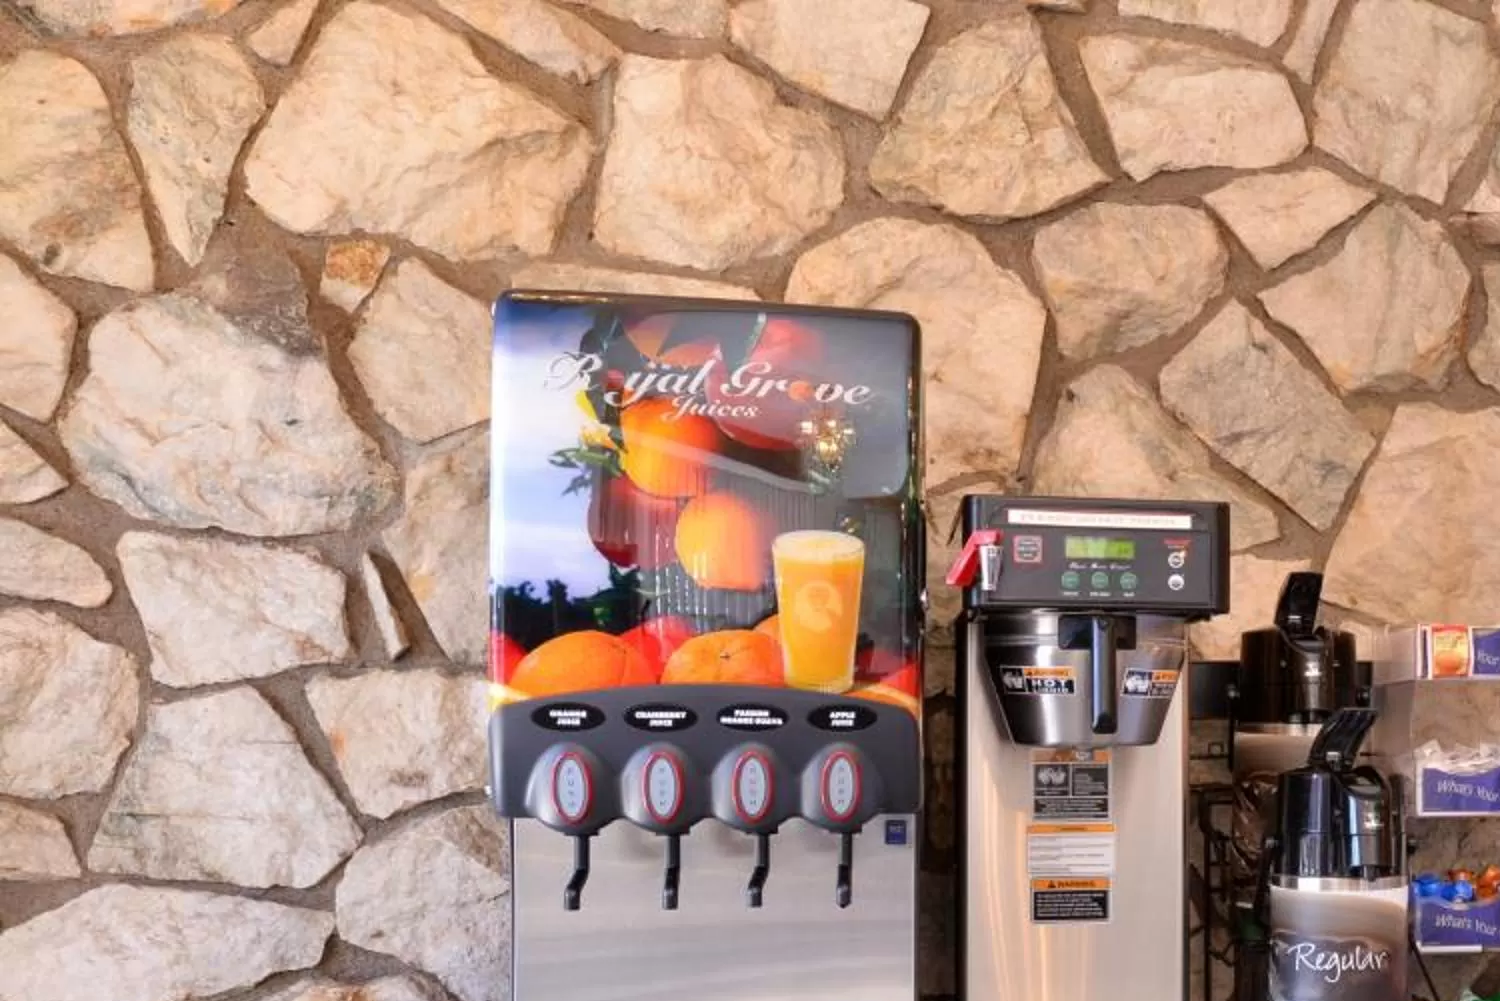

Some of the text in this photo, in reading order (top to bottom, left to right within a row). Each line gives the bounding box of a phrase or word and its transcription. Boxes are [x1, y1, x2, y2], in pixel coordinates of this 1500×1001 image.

[720, 362, 872, 405] Grove
[663, 394, 760, 422] Juices
[828, 711, 855, 719] APPLE
[1287, 942, 1388, 982] Regular
